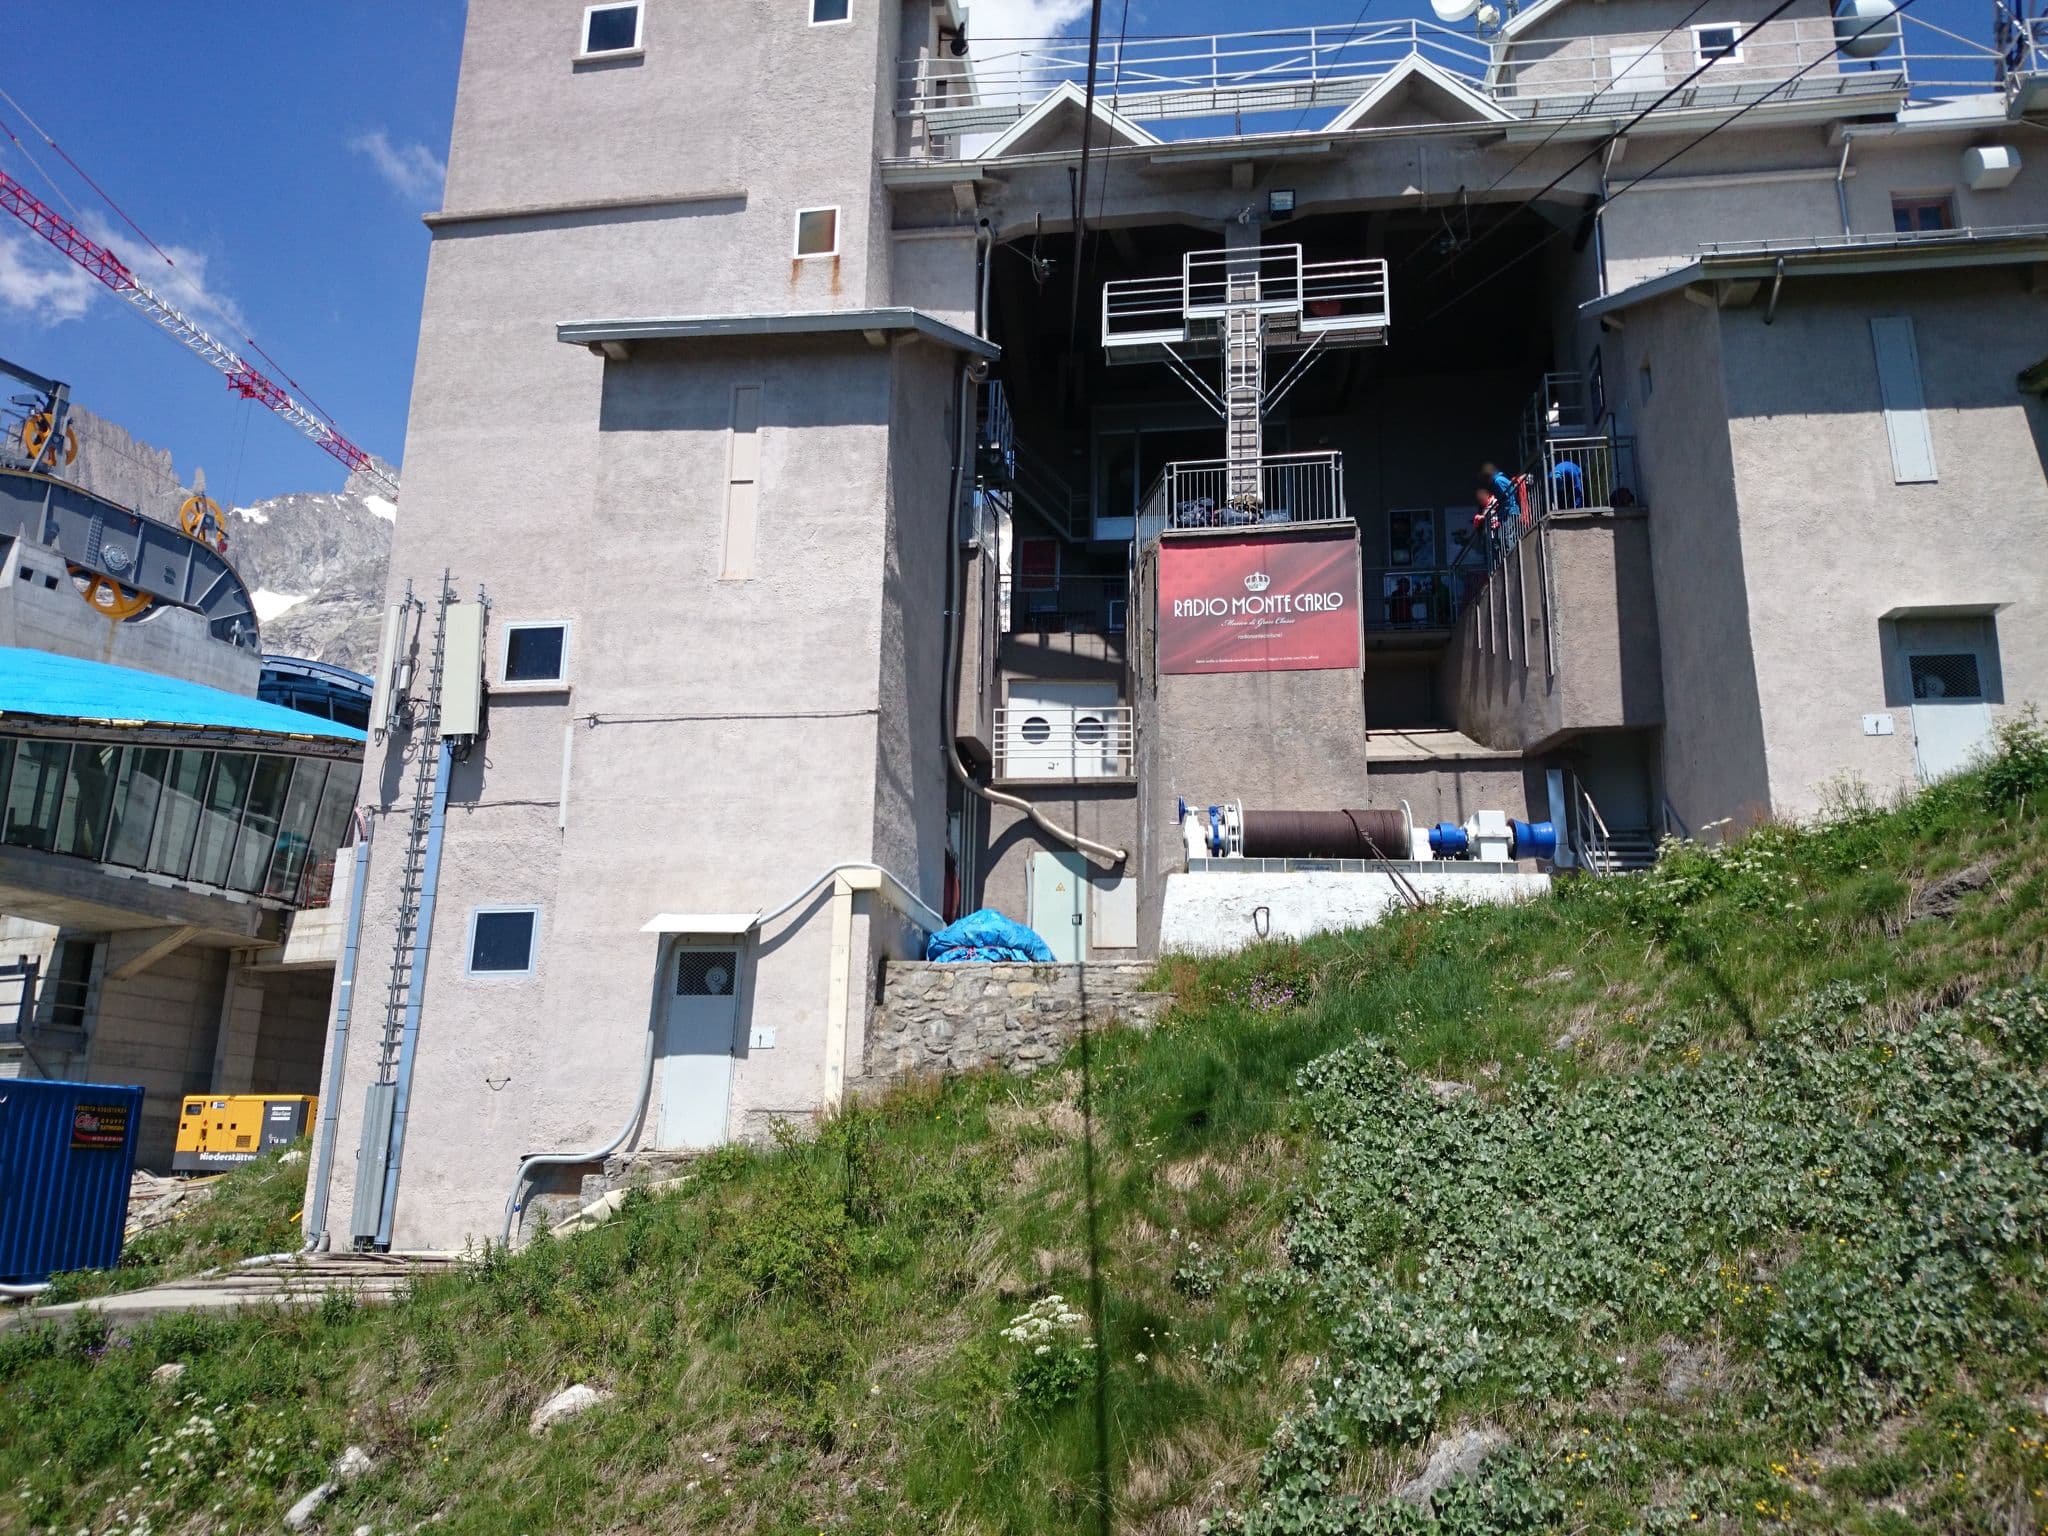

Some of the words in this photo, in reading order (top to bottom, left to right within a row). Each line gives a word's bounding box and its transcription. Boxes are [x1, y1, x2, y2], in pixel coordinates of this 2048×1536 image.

[1174, 598, 1228, 617] RADIO
[1232, 595, 1292, 615] MONTE
[1294, 592, 1343, 611] CARLO
